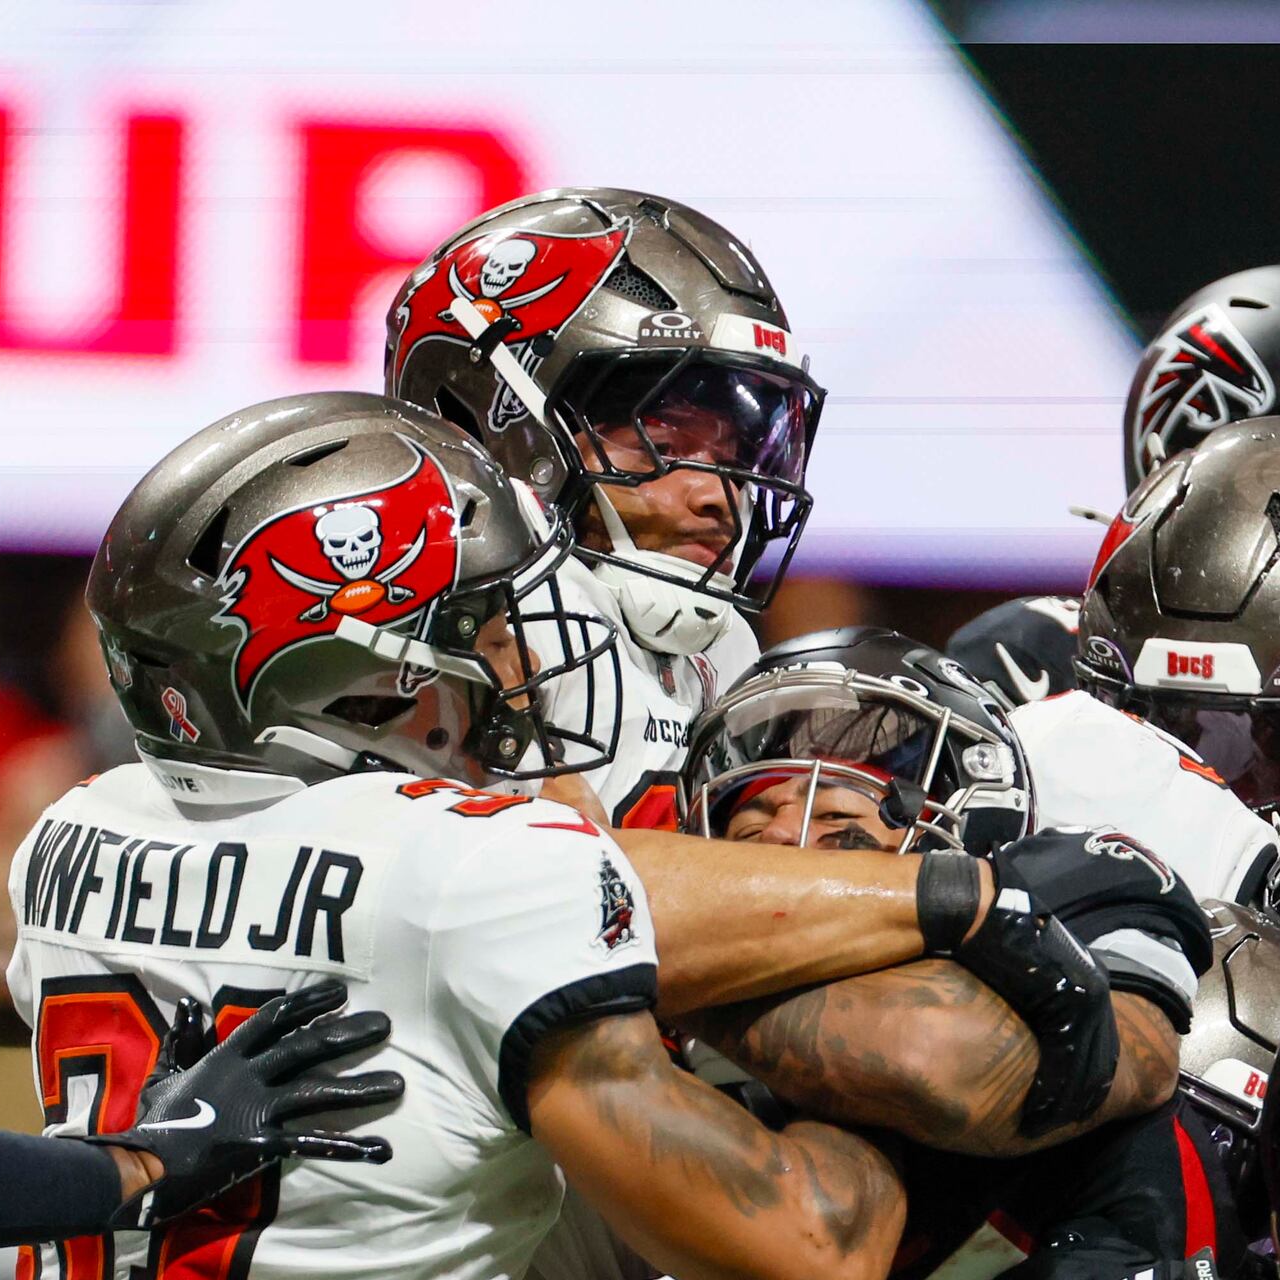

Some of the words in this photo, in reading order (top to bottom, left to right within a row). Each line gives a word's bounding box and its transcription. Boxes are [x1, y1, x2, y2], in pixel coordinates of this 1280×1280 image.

[641, 328, 704, 339] OAKLEY
[22, 818, 248, 949] WINFIELD
[247, 846, 364, 963] JR
